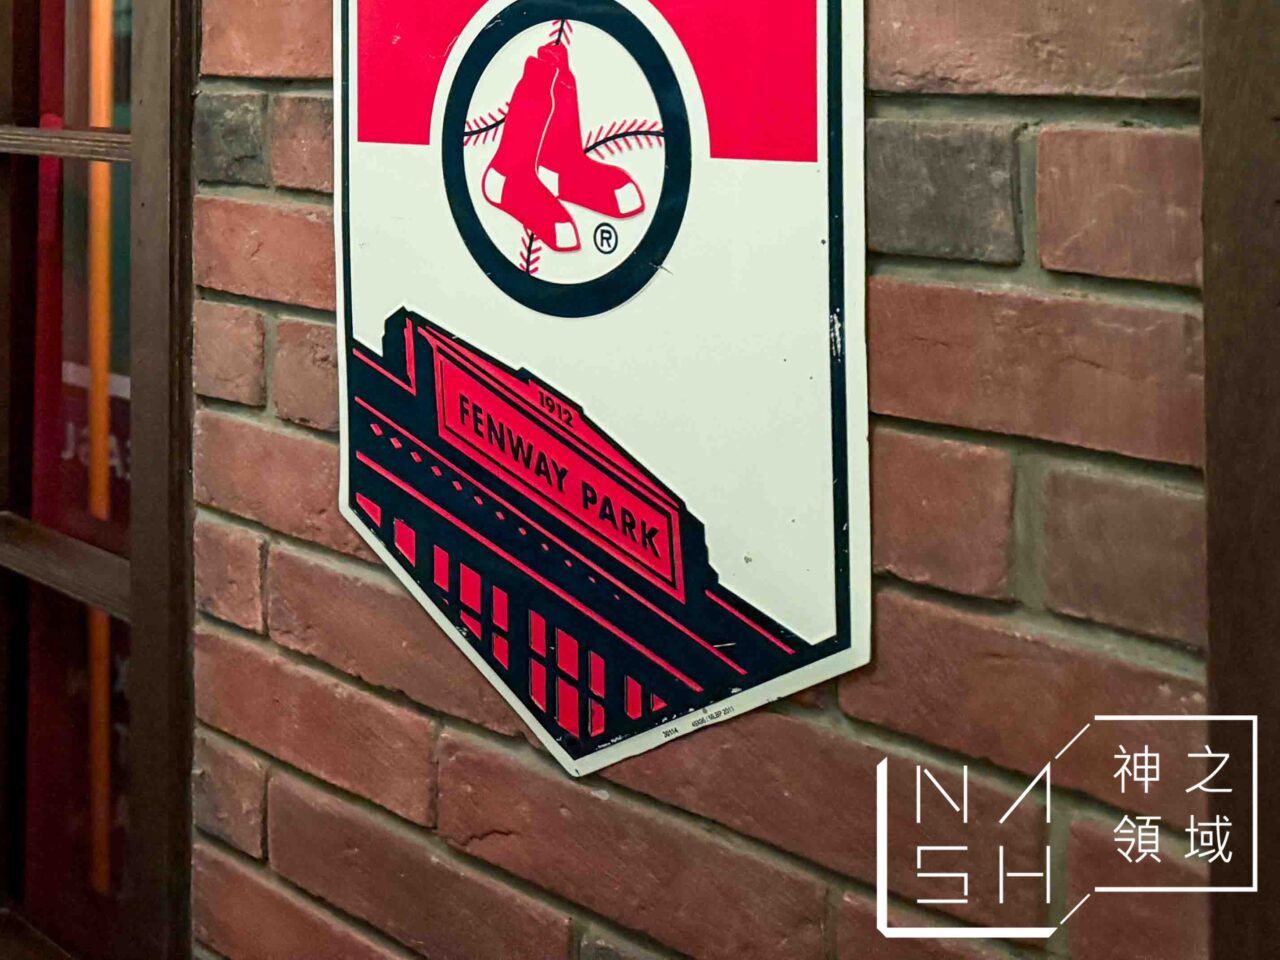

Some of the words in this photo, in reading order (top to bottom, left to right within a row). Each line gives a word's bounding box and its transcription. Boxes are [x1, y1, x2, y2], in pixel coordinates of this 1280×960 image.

[537, 389, 575, 429] 1912
[457, 392, 569, 493] FENWAY
[582, 486, 662, 560] PARK
